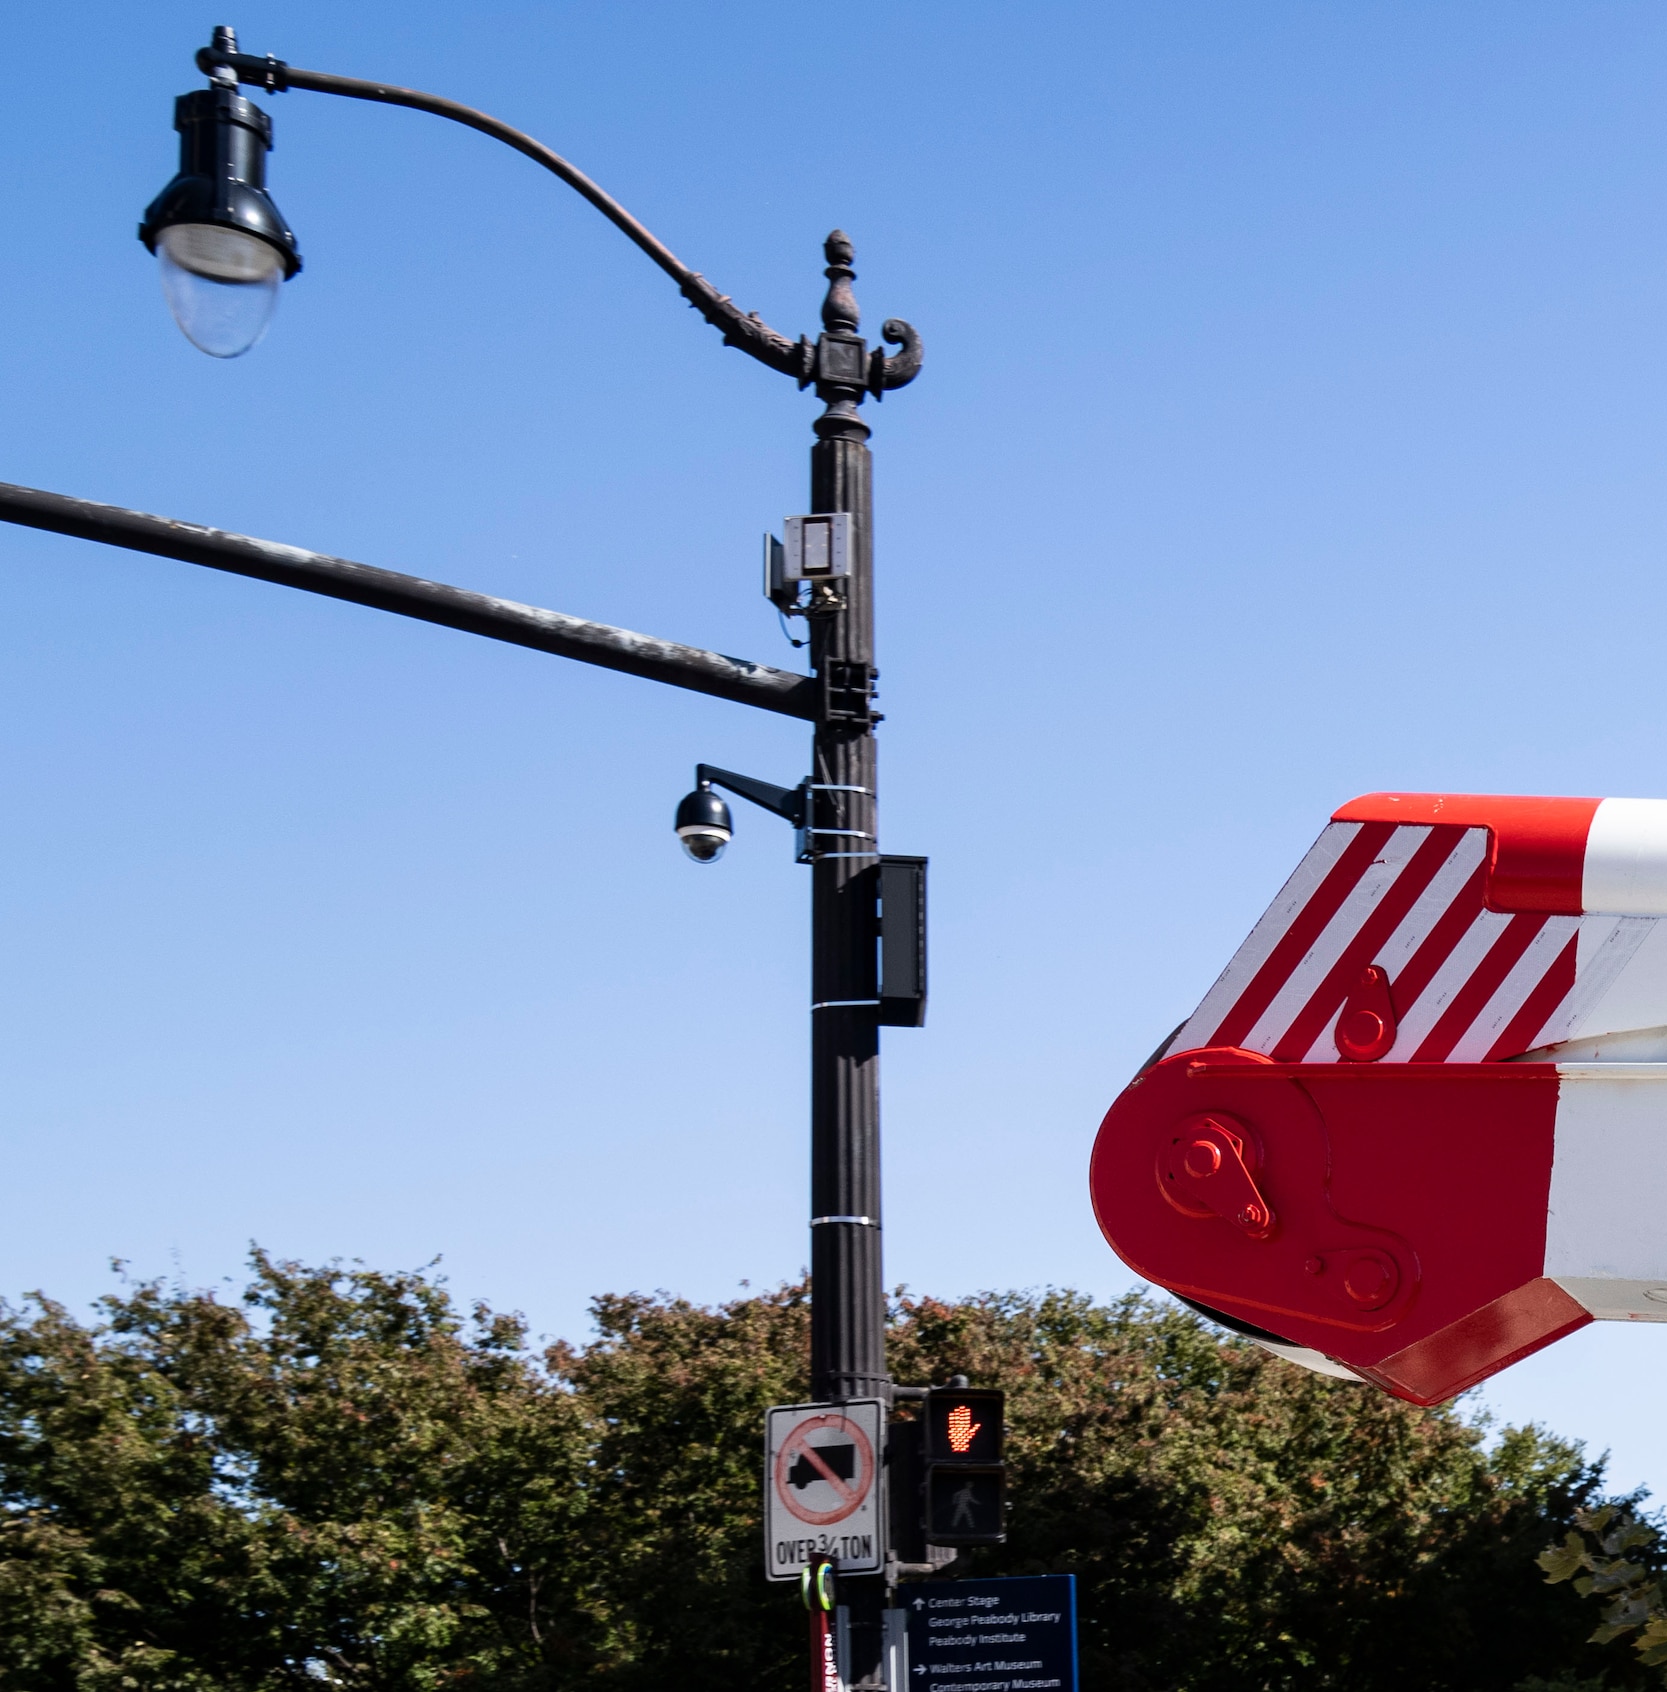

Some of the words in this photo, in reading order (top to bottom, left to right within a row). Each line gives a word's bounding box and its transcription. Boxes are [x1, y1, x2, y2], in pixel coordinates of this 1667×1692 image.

[776, 1539, 816, 1564] OVER
[841, 1535, 872, 1560] TON
[928, 1598, 965, 1608] Center
[967, 1596, 1000, 1608] Stage
[928, 1617, 969, 1628] George
[970, 1613, 1020, 1625] Peabody
[1021, 1612, 1061, 1623] Library
[929, 1635, 978, 1646] Peabody
[979, 1632, 1026, 1643] Institute
[929, 1663, 972, 1673] Walters
[973, 1661, 993, 1671] Art
[994, 1660, 1043, 1670] Museum
[1012, 1678, 1061, 1688] Museum
